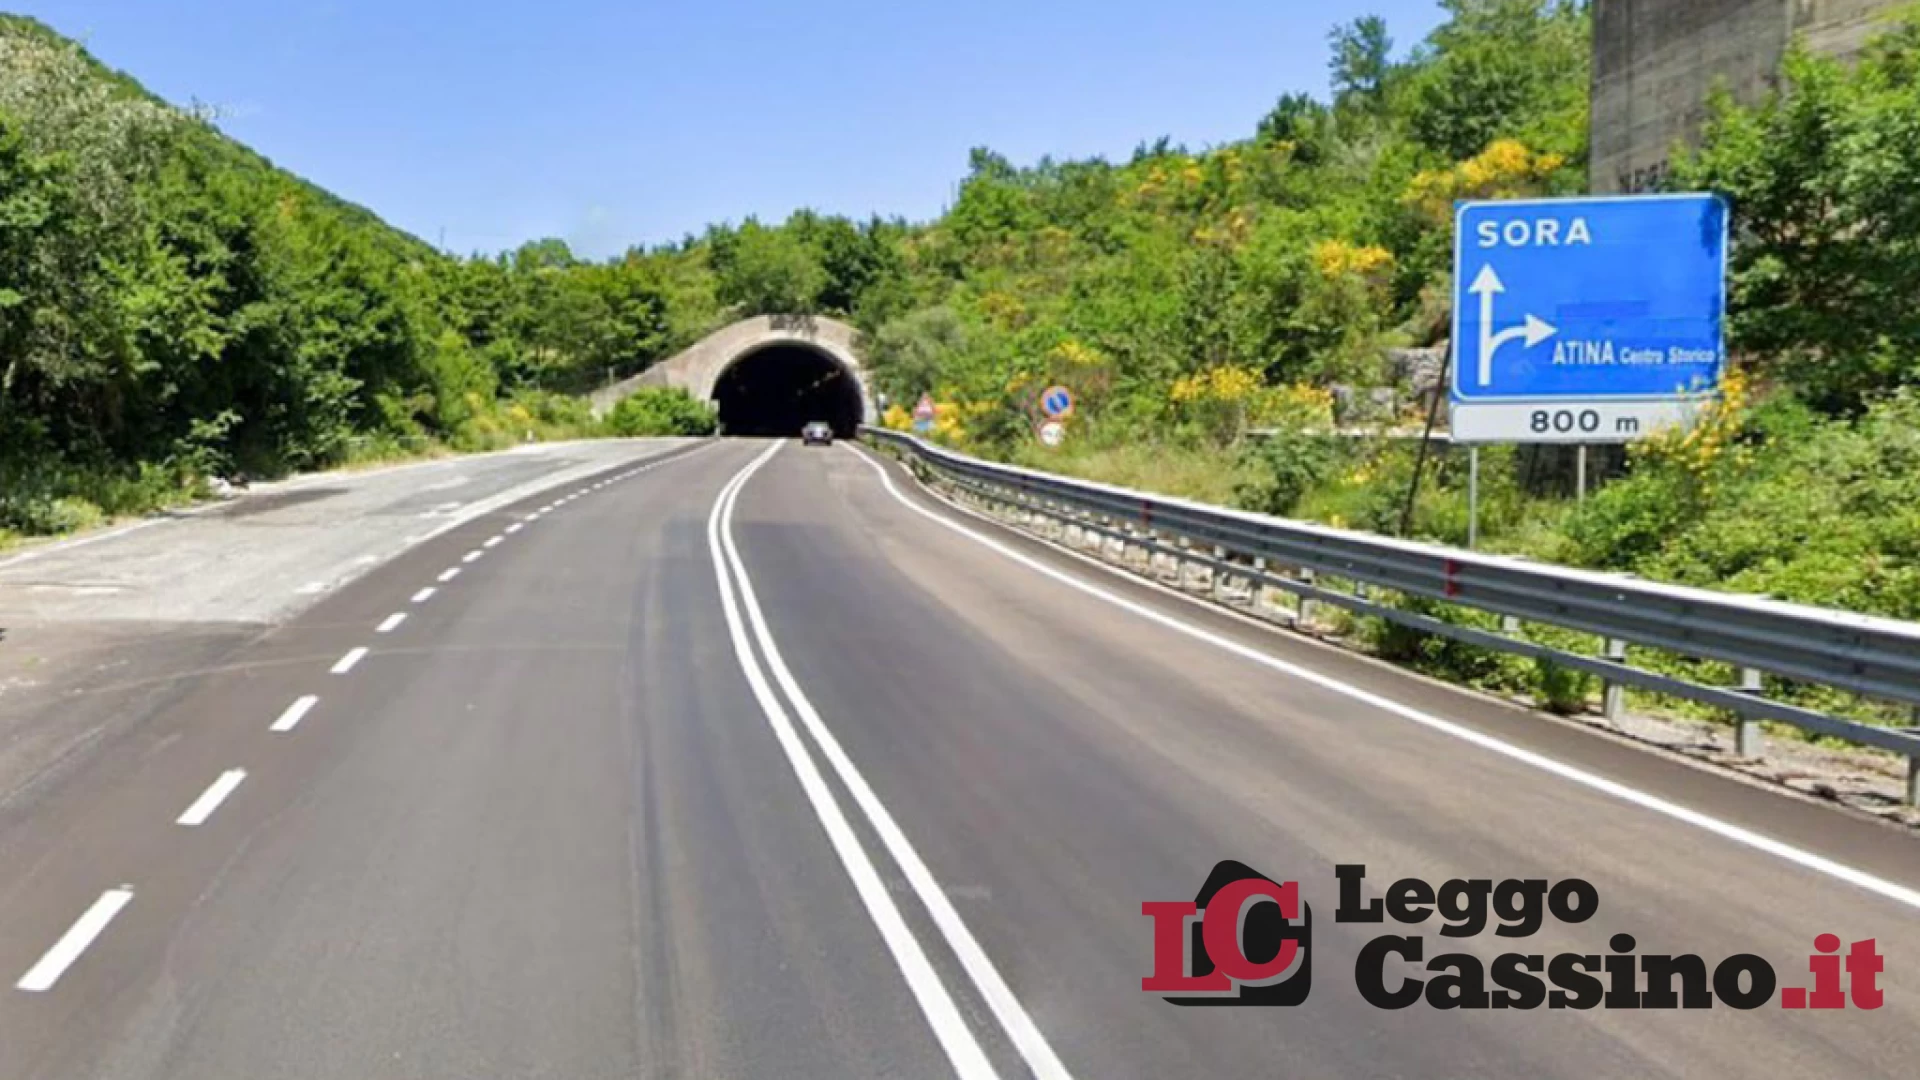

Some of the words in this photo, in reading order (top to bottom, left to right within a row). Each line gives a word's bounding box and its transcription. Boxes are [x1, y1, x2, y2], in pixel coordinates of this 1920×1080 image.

[1477, 218, 1591, 247] SORA
[1552, 340, 1615, 365] ATINA
[1530, 409, 1600, 433] 800
[1615, 416, 1639, 433] m
